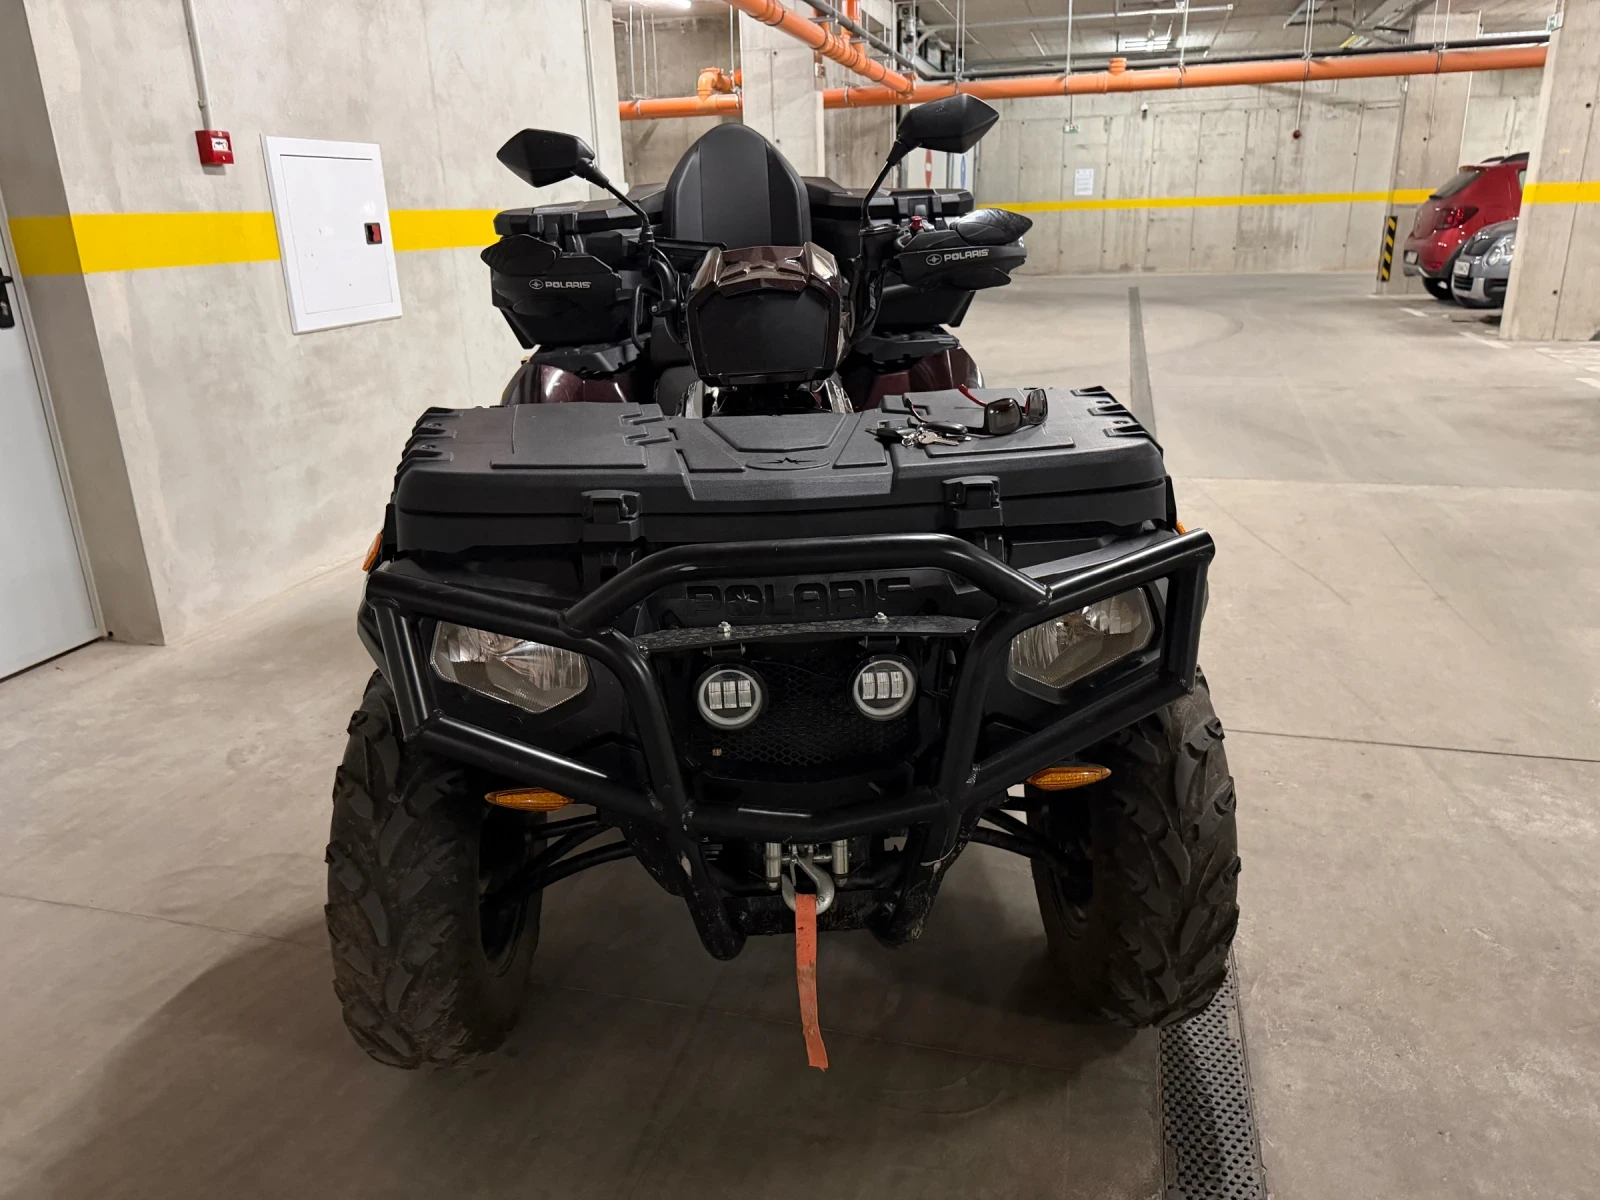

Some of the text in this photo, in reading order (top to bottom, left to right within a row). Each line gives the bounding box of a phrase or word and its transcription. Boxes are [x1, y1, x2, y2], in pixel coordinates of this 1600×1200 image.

[944, 249, 990, 262] POLARIS
[545, 281, 592, 289] POLARIS
[685, 576, 912, 617] POLARIS
